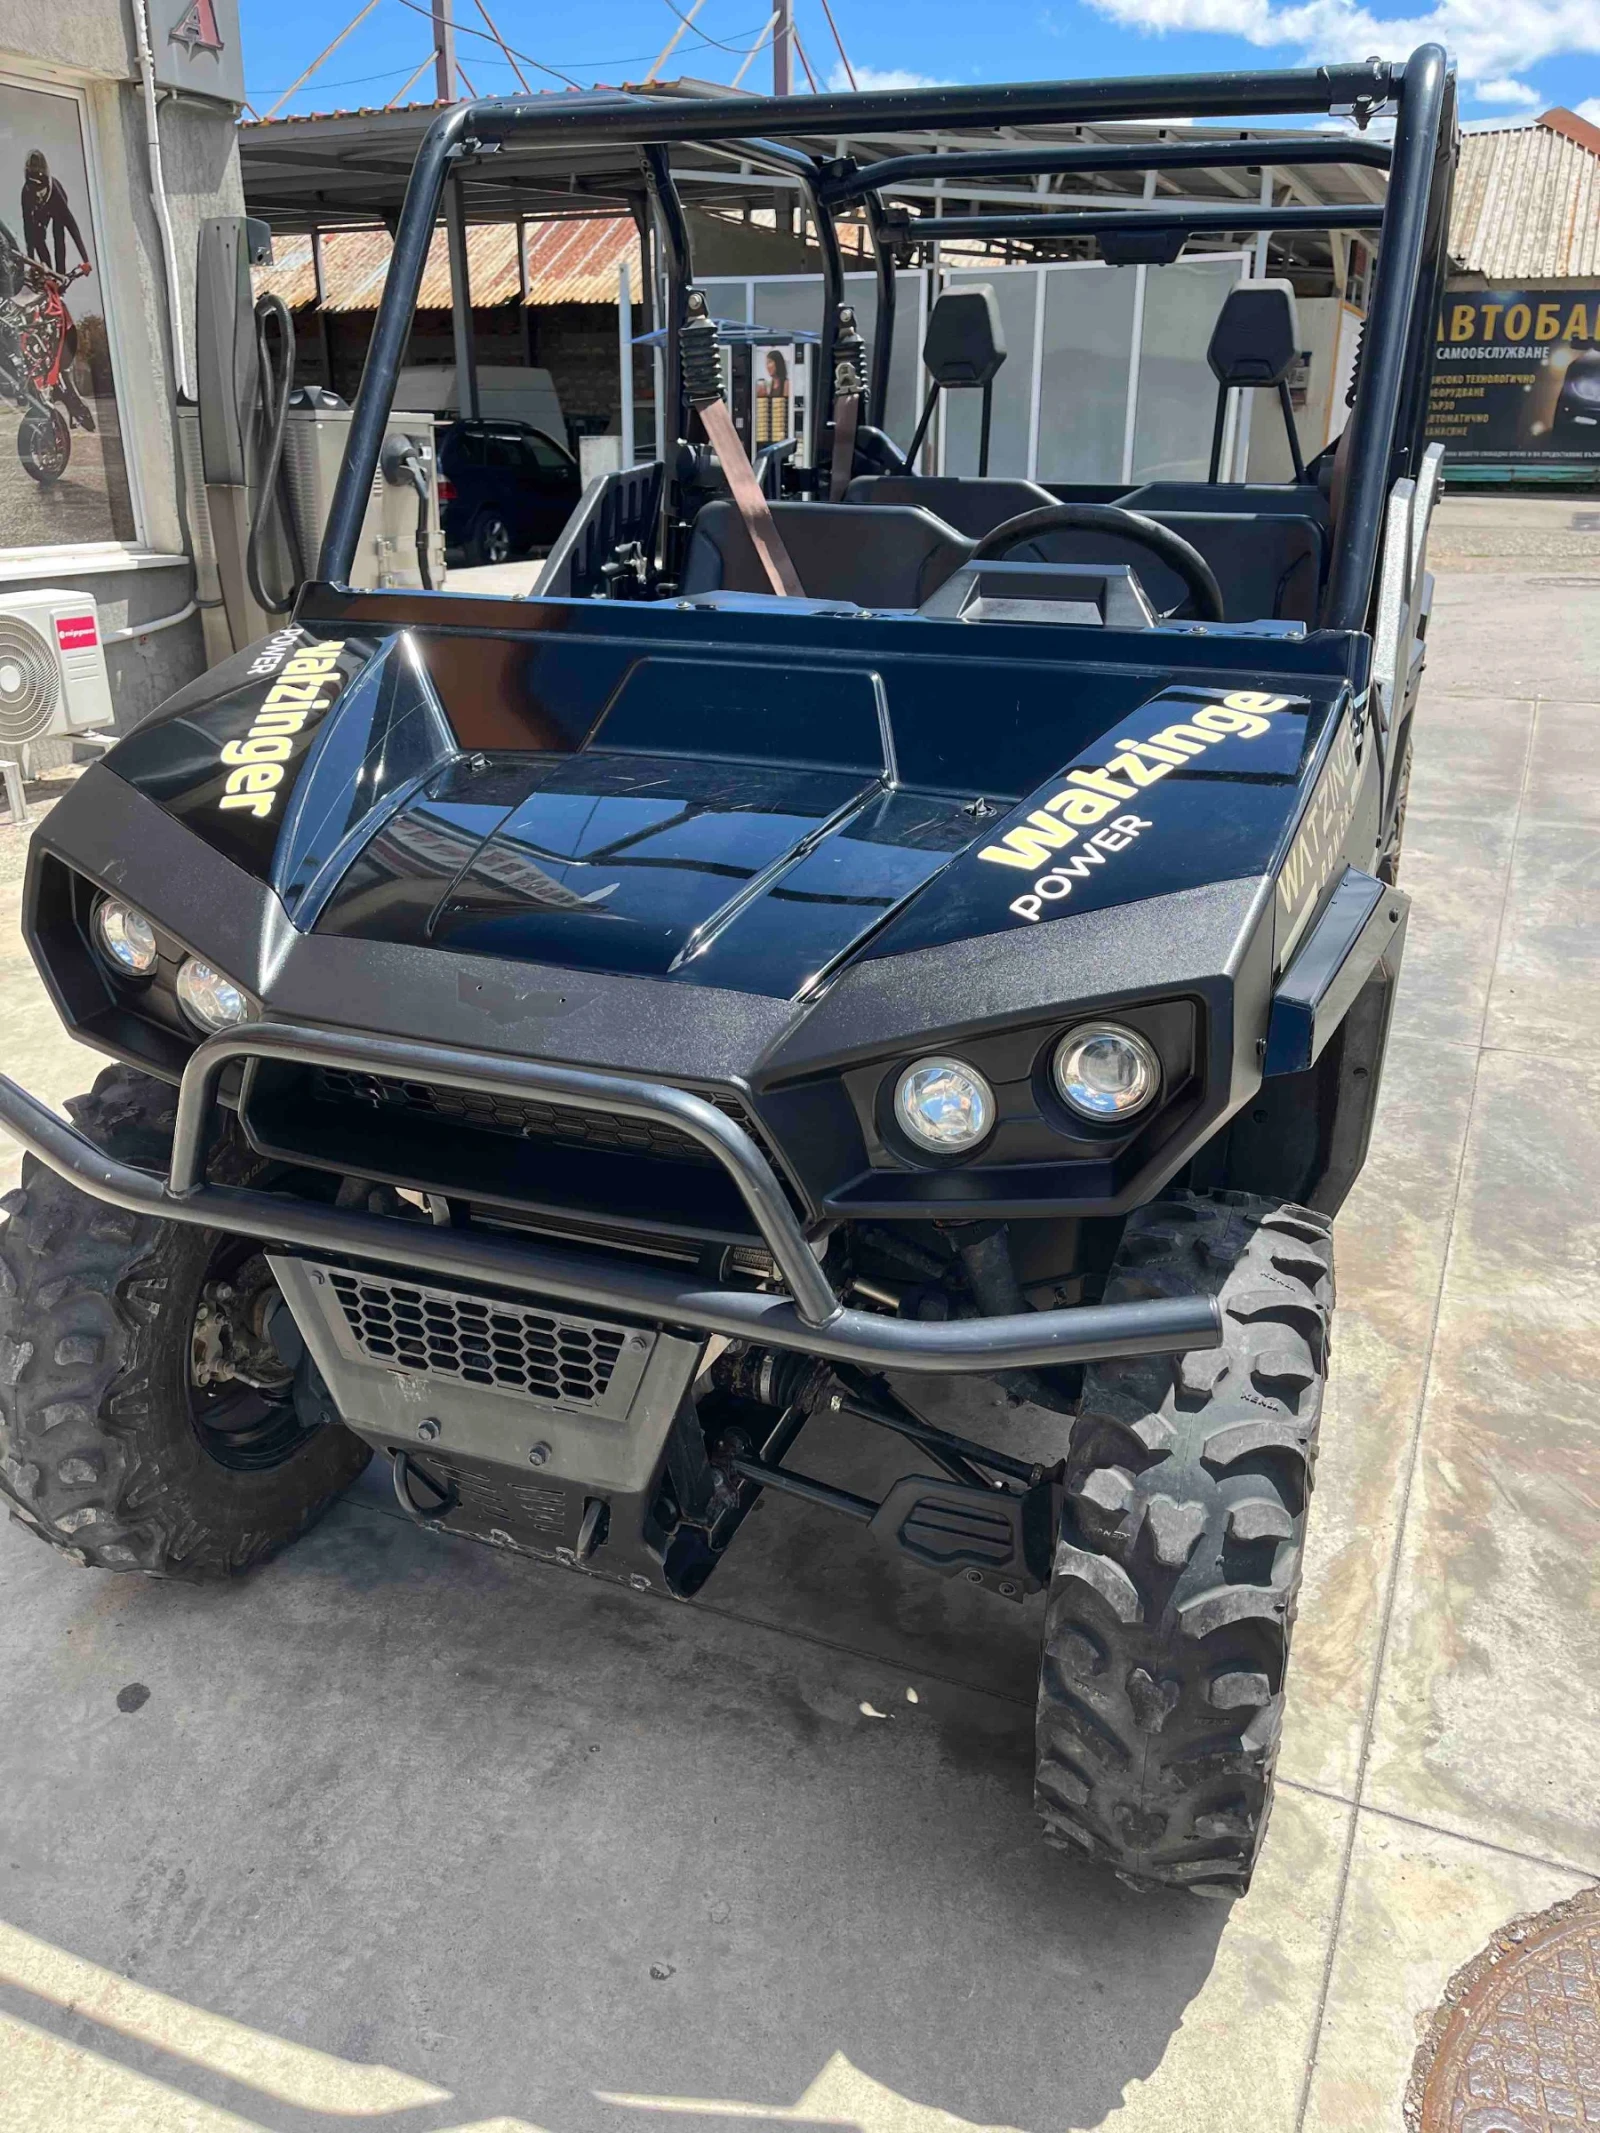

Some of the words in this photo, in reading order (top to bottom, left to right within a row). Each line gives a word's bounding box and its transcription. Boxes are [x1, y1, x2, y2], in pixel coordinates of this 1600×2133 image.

[1437, 303, 1600, 342] ВТОБА
[1436, 346, 1550, 360] САМООБСЛУЖВАНЕ
[246, 628, 304, 675] POWER
[1008, 813, 1153, 921] POWER
